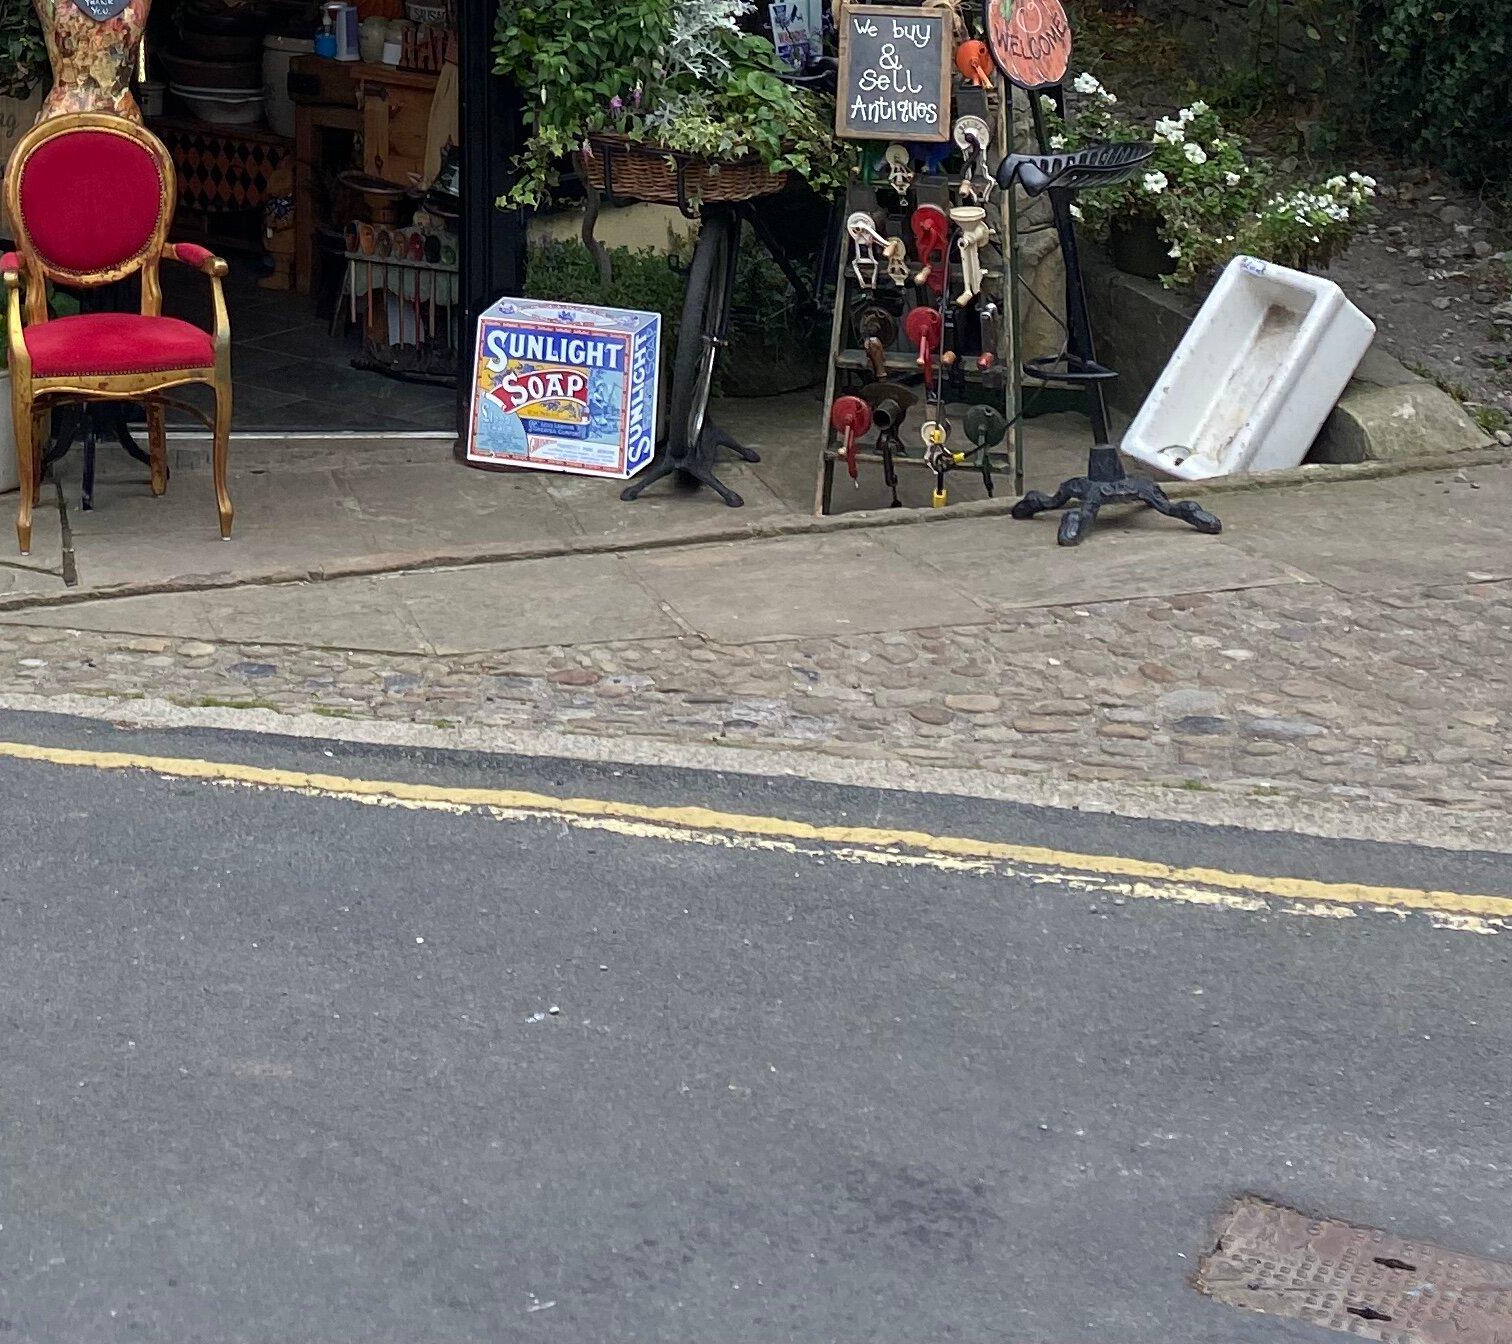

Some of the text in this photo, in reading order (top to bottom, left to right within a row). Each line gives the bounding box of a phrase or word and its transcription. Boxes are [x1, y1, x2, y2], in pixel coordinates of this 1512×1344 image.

[853, 18, 931, 49] We buy
[994, 12, 1068, 61] WELCOME
[879, 43, 904, 70] &
[850, 94, 938, 124] Antiques
[487, 329, 624, 373] SUNLIGHT
[502, 371, 584, 407] SOAP
[628, 334, 651, 463] SUNLIGHT
